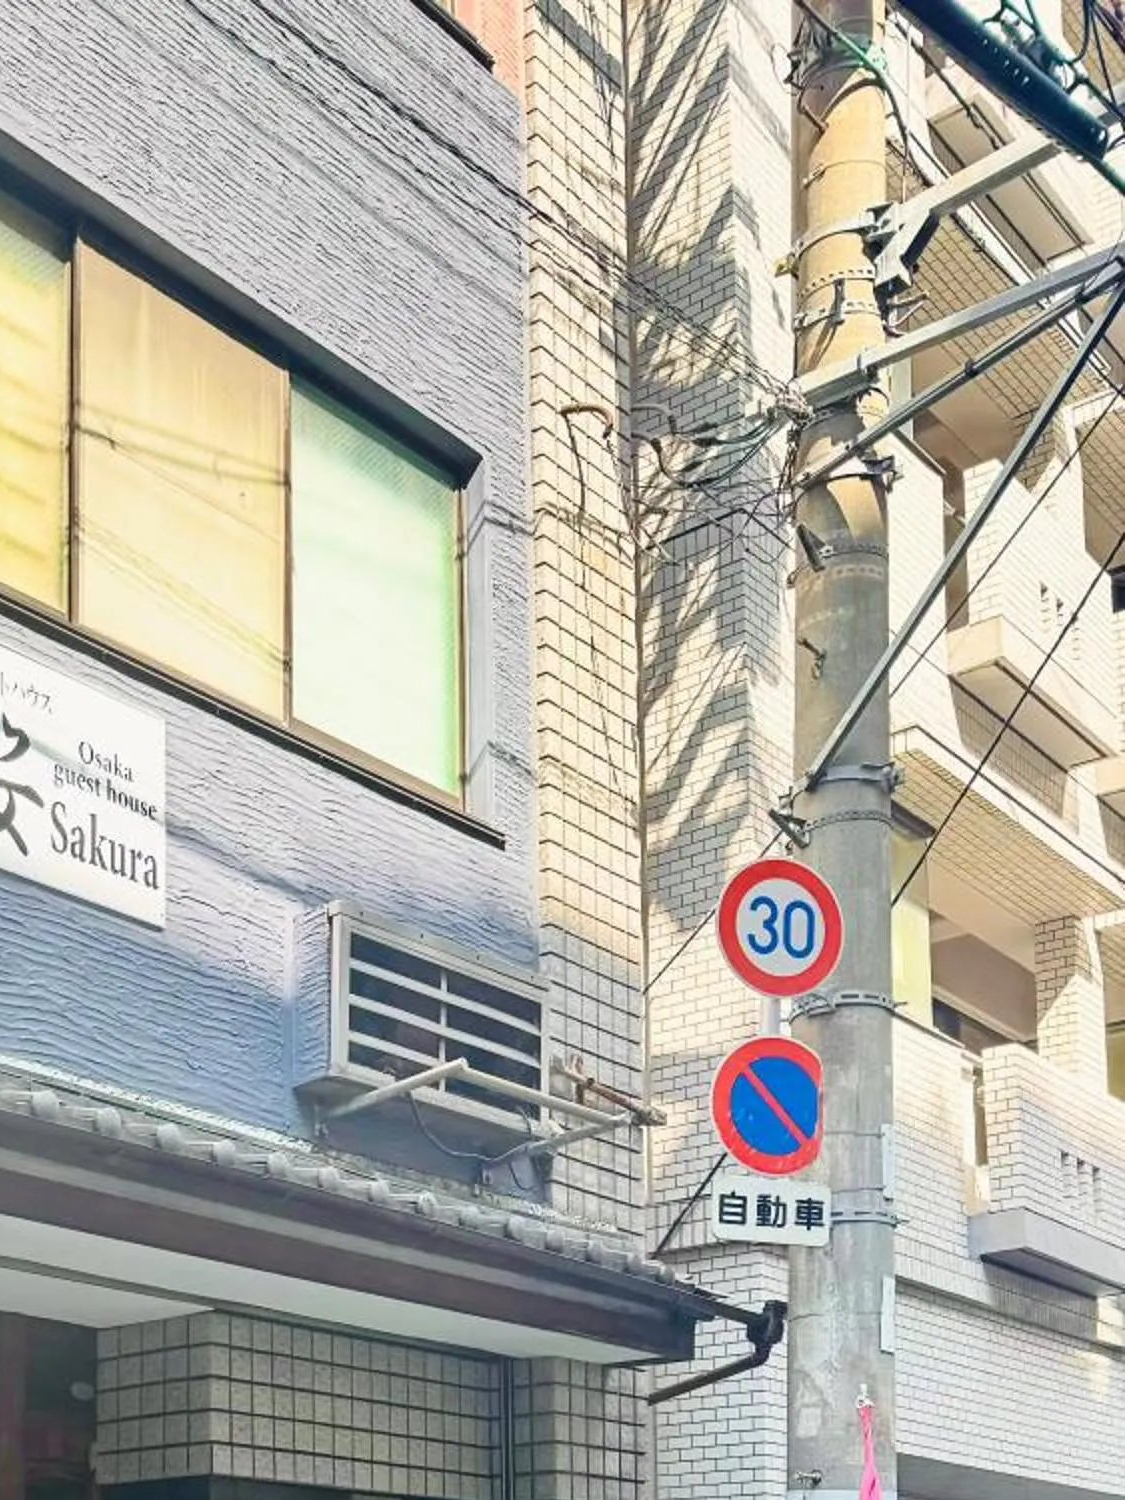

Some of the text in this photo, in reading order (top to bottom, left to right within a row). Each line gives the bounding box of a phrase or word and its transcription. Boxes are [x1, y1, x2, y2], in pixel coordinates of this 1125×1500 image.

[54, 762, 158, 820] guest house
[78, 741, 134, 783] Osaka
[50, 800, 159, 890] Sakura
[747, 895, 816, 960] 30
[718, 1191, 826, 1231] 自動車
